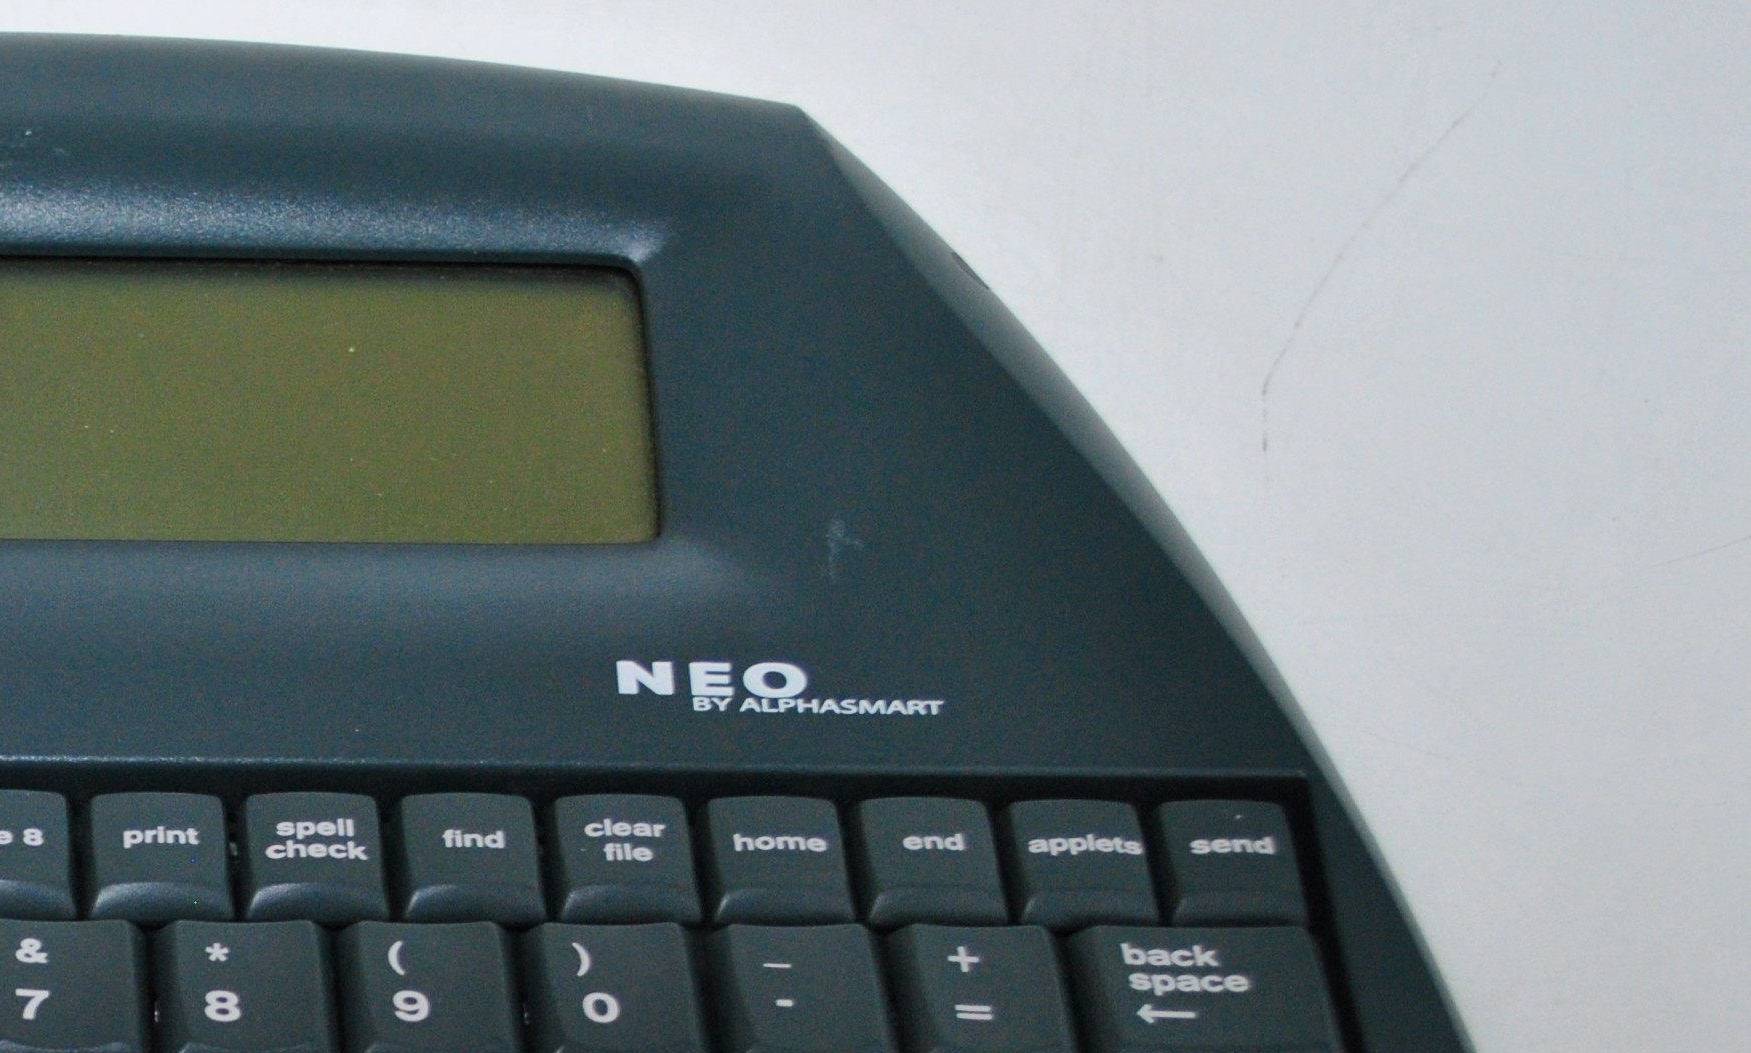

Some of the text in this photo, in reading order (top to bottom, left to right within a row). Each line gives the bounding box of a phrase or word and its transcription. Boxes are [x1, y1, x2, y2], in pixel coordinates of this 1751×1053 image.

[616, 661, 807, 697] NEO
[692, 697, 944, 715] BY ALPHASMART
[22, 827, 44, 847] 8
[122, 825, 200, 849] print
[276, 817, 355, 841] spell
[442, 828, 506, 849] find
[584, 818, 666, 838] clear
[265, 839, 368, 861] check
[603, 842, 654, 862] file
[732, 833, 828, 853] home
[902, 832, 966, 851] end
[1028, 833, 1144, 856] applets
[1189, 836, 1276, 855] send
[15, 937, 48, 964] &
[387, 940, 406, 974] (
[571, 942, 591, 977] )
[947, 945, 980, 973] +
[1120, 942, 1220, 968] back
[1128, 972, 1251, 997] space
[15, 988, 51, 1020] 7
[204, 989, 242, 1023] 8
[392, 989, 430, 1022] 9
[954, 1003, 994, 1021] =
